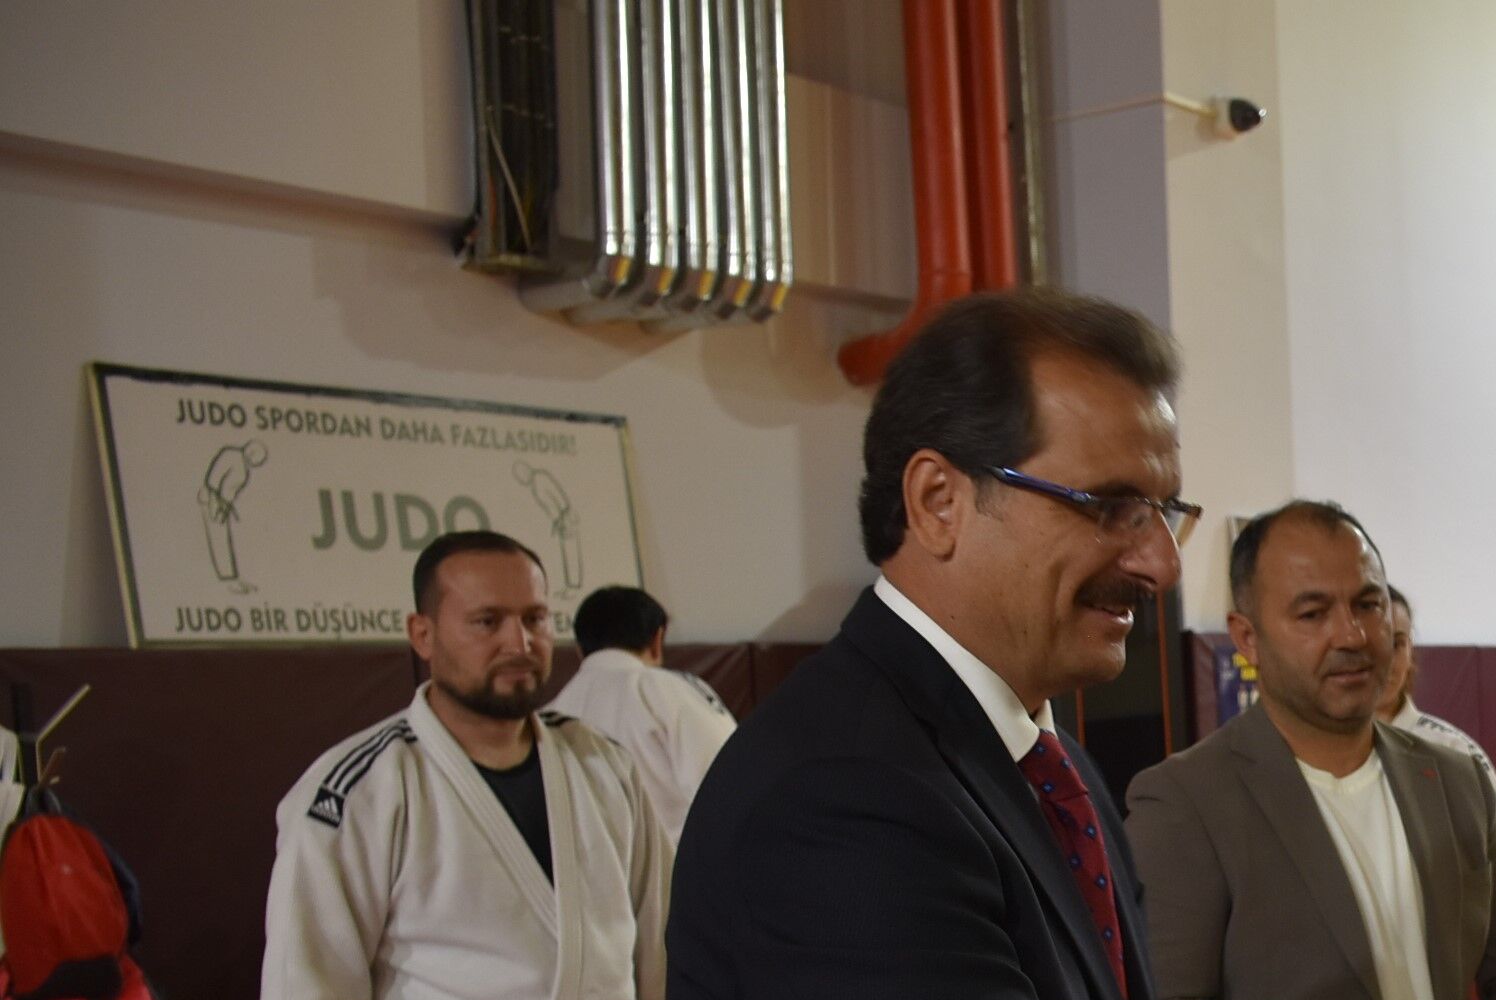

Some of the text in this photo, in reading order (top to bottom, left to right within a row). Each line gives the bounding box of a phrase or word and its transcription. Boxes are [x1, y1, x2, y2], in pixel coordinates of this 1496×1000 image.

[176, 398, 247, 428] JUDO
[255, 405, 373, 439] SPORDAN
[379, 416, 446, 445] DAHA
[175, 602, 402, 641] JUDO BİR DÜŞÜNCE
